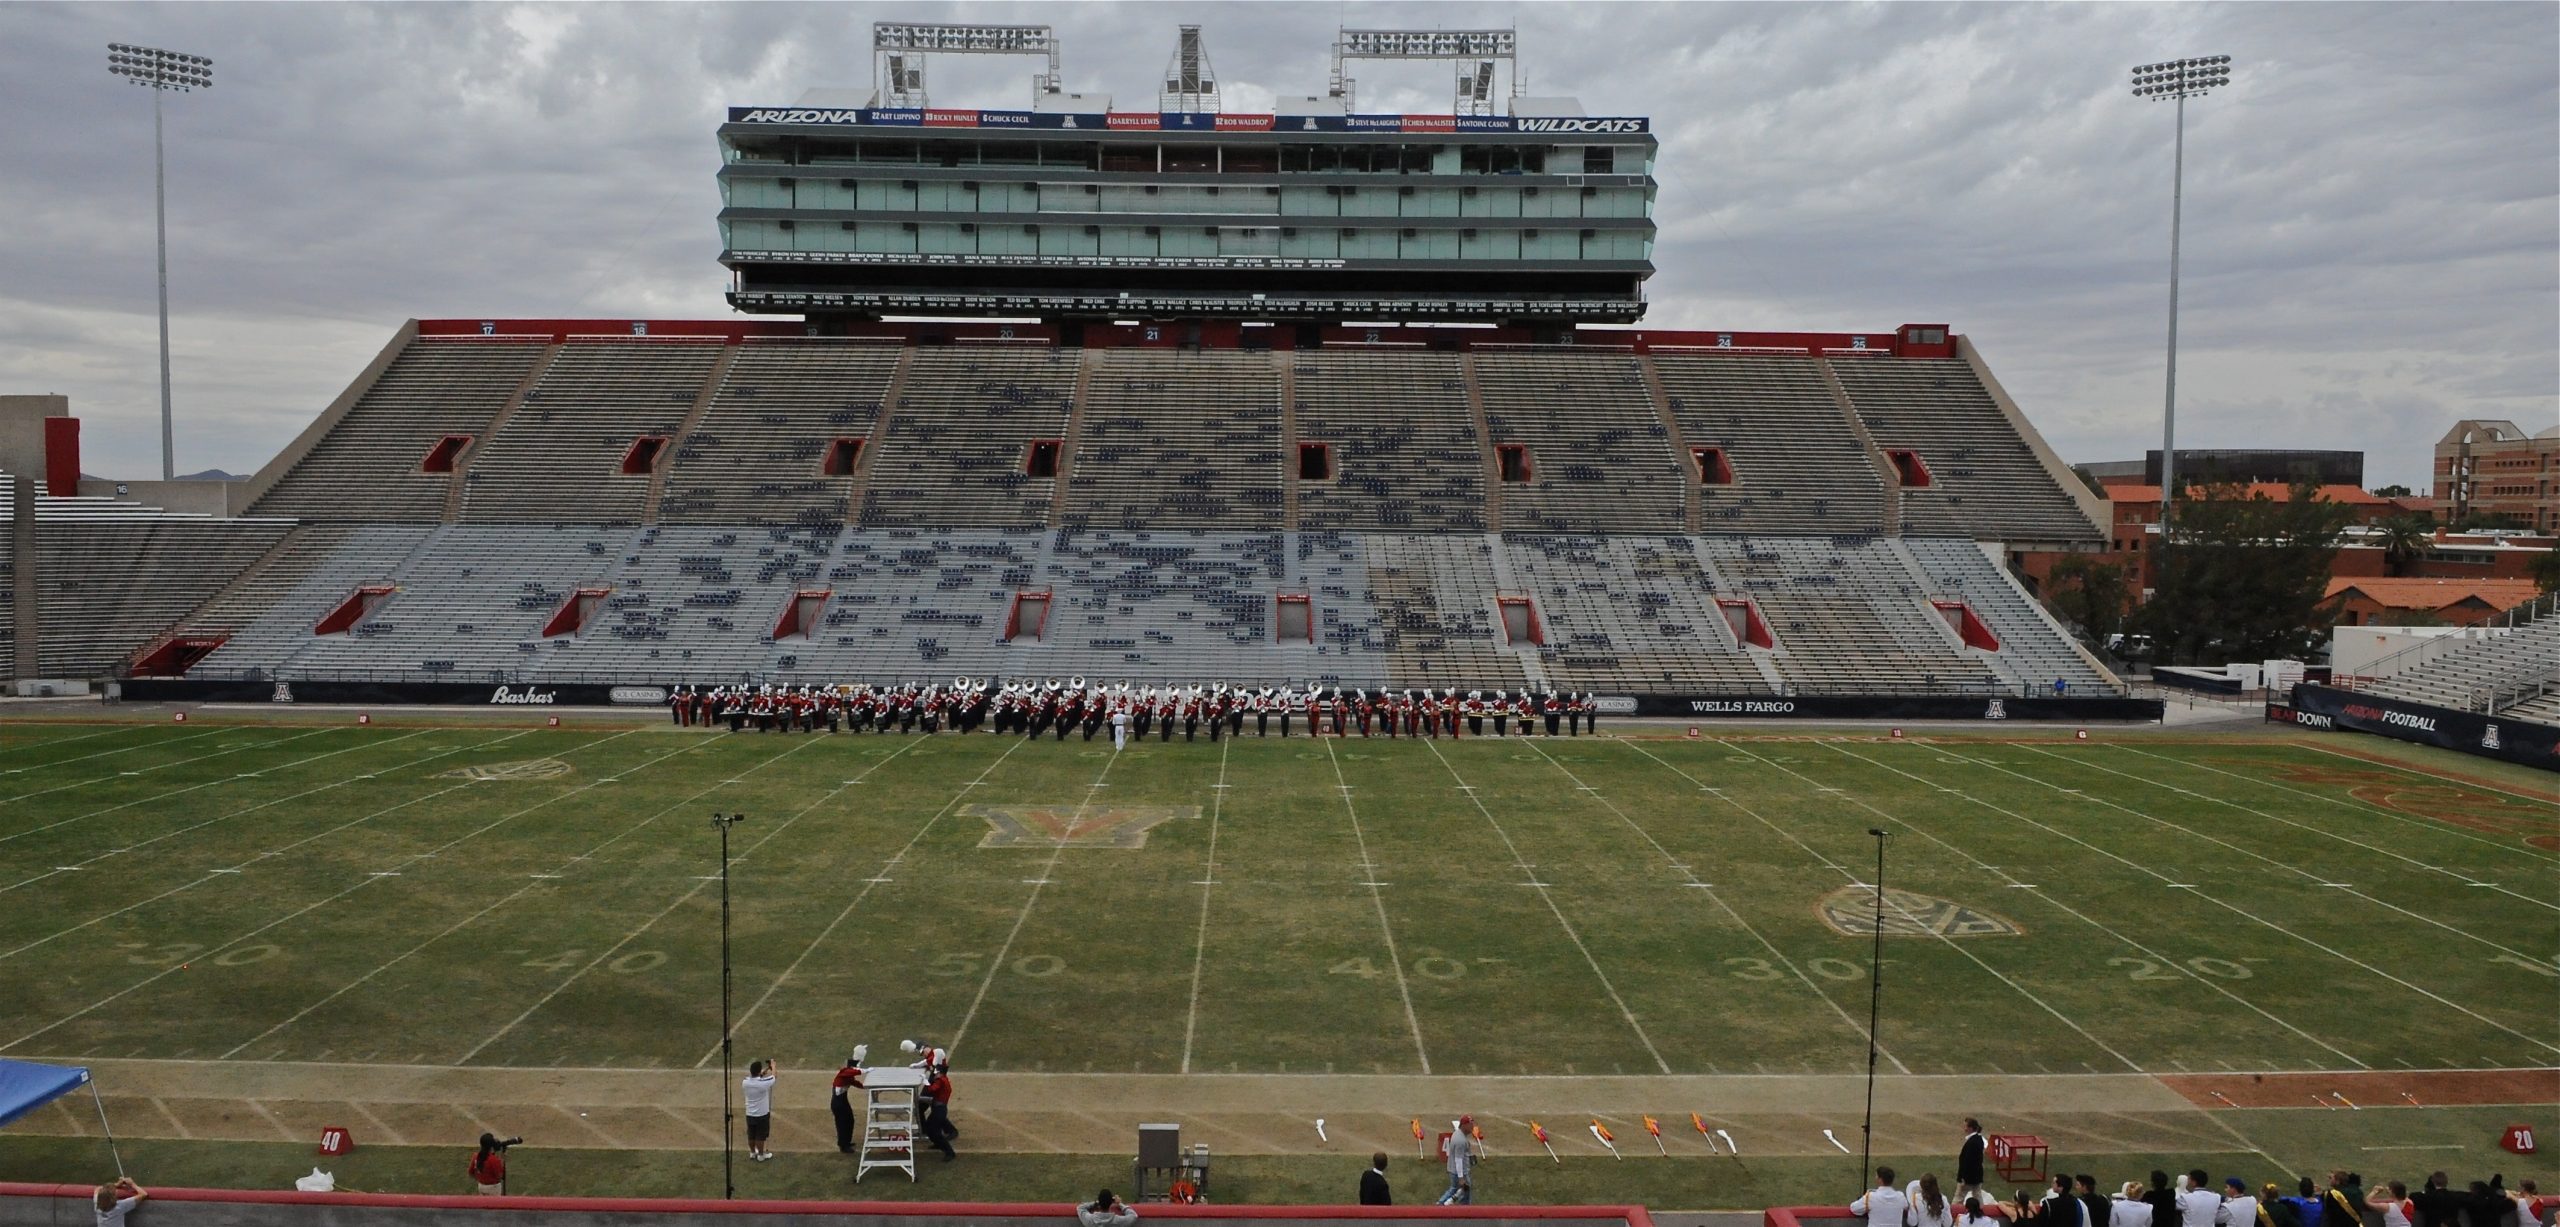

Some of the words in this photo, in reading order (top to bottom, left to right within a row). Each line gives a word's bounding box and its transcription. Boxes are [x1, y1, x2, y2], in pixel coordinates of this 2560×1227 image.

[742, 110, 857, 123] ARIZONA
[871, 111, 880, 120] 22
[1487, 120, 1509, 128] CASON
[1517, 118, 1642, 132] WILDCATS
[483, 326, 493, 335] 17
[634, 327, 645, 336] 18
[1000, 330, 1014, 338] 20
[1147, 331, 1158, 340] 21
[1366, 333, 1379, 342] 22
[1718, 338, 1731, 347] 24
[1853, 340, 1866, 349] 25
[117, 485, 128, 494] 16
[490, 686, 556, 704] Bashas'
[630, 690, 661, 698] CASINOS
[1601, 701, 1632, 709] CASINOS
[1691, 701, 1743, 712] WELLS
[1745, 701, 1795, 713] FARGO
[2296, 711, 2331, 728] DOWN
[2381, 710, 2436, 732] FOOTBALL
[322, 1131, 341, 1152] 40
[2514, 1130, 2534, 1150] 20
